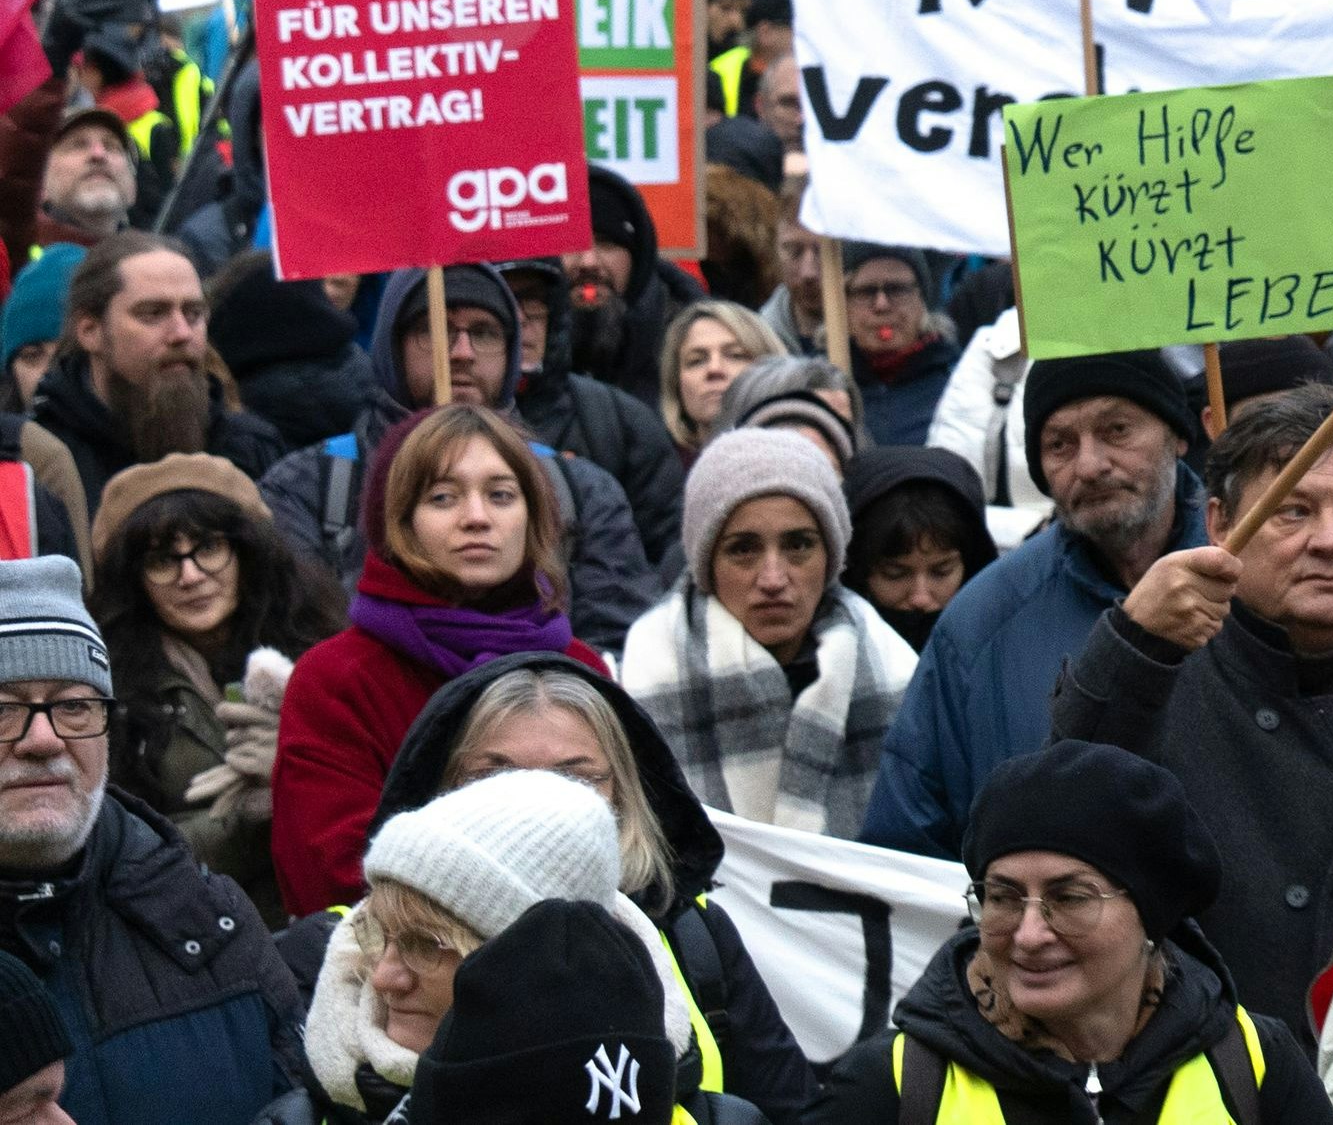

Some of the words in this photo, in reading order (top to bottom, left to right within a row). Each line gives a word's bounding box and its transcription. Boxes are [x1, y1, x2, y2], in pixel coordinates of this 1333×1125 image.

[277, 0, 362, 43] FÜR
[282, 39, 520, 91] KOLLEKTIV-
[284, 88, 485, 138] VERTRAG!
[1008, 114, 1103, 175] Wer
[1138, 104, 1256, 190] Hilfe
[446, 161, 568, 233] gpa
